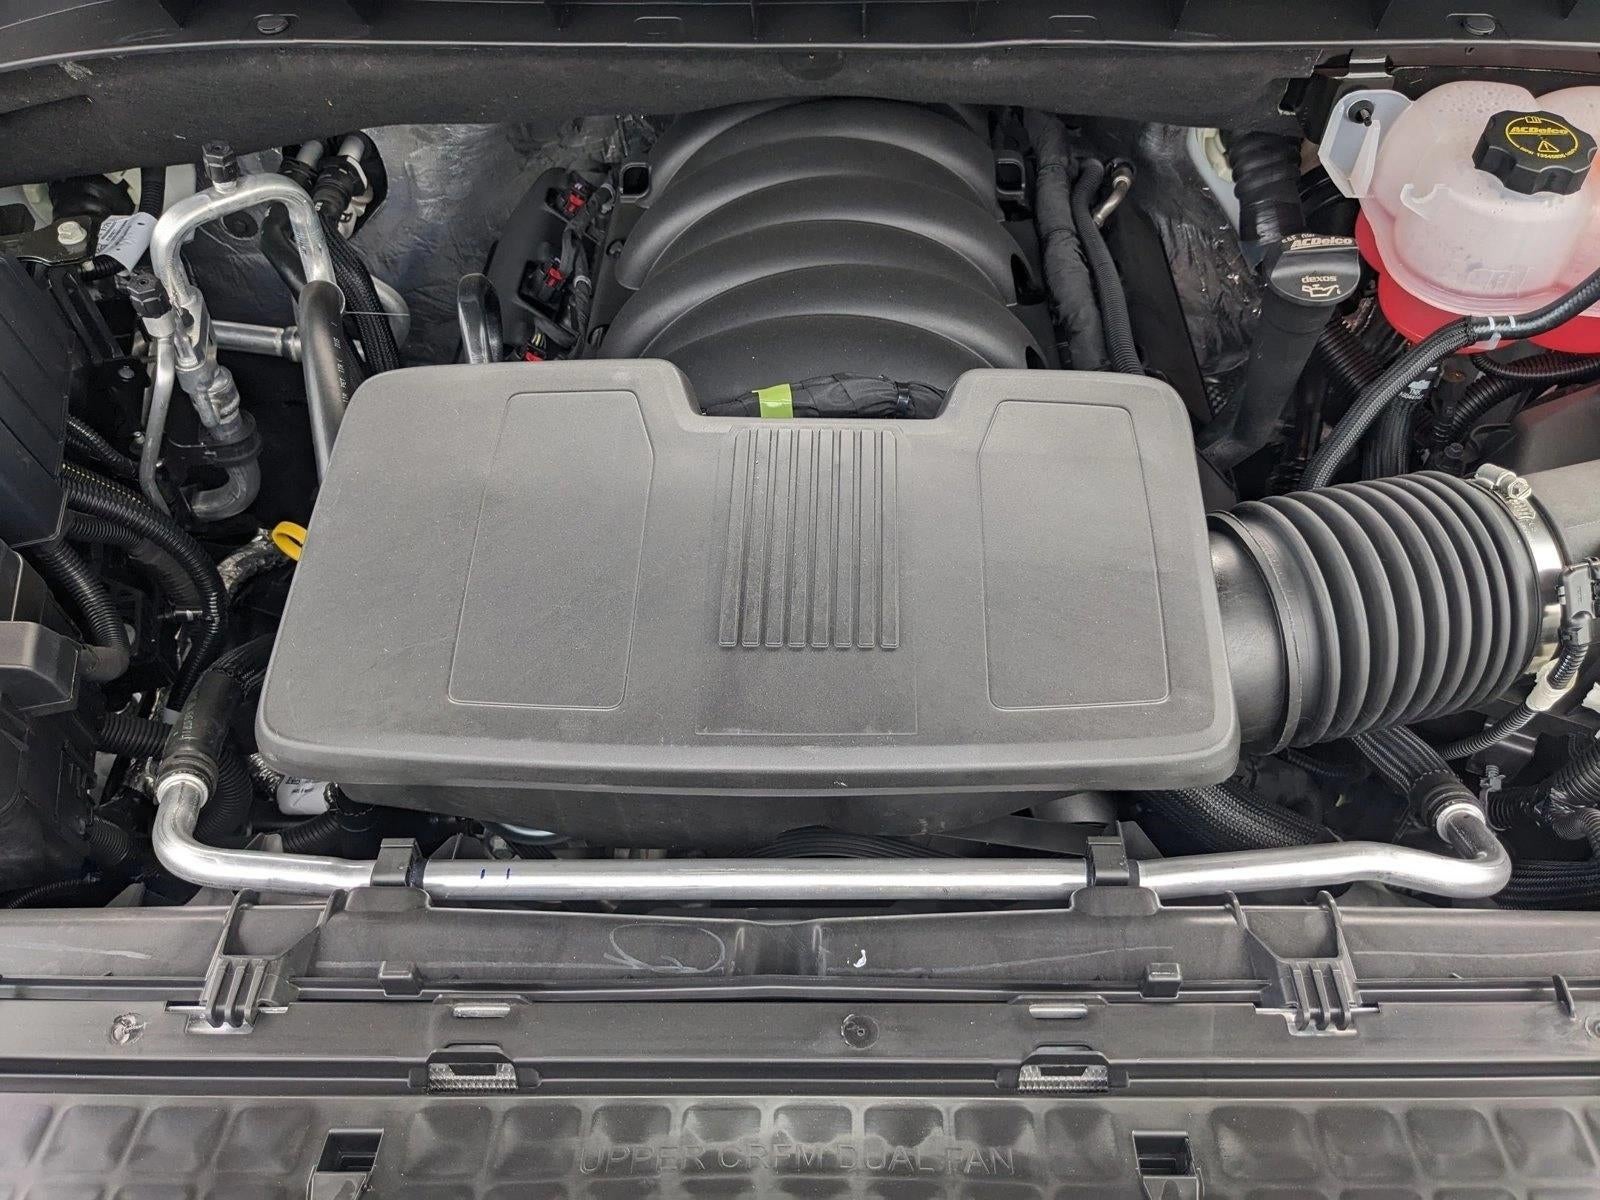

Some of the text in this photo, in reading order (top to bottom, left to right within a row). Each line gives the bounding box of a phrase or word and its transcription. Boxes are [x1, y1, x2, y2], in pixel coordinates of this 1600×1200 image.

[1508, 126, 1569, 136] ACDelco
[1290, 236, 1354, 251] ACDelco
[1301, 275, 1337, 284] dexos
[579, 1145, 706, 1175] UPPER
[837, 1144, 935, 1173] DUAL
[946, 1147, 1015, 1175] FAN
